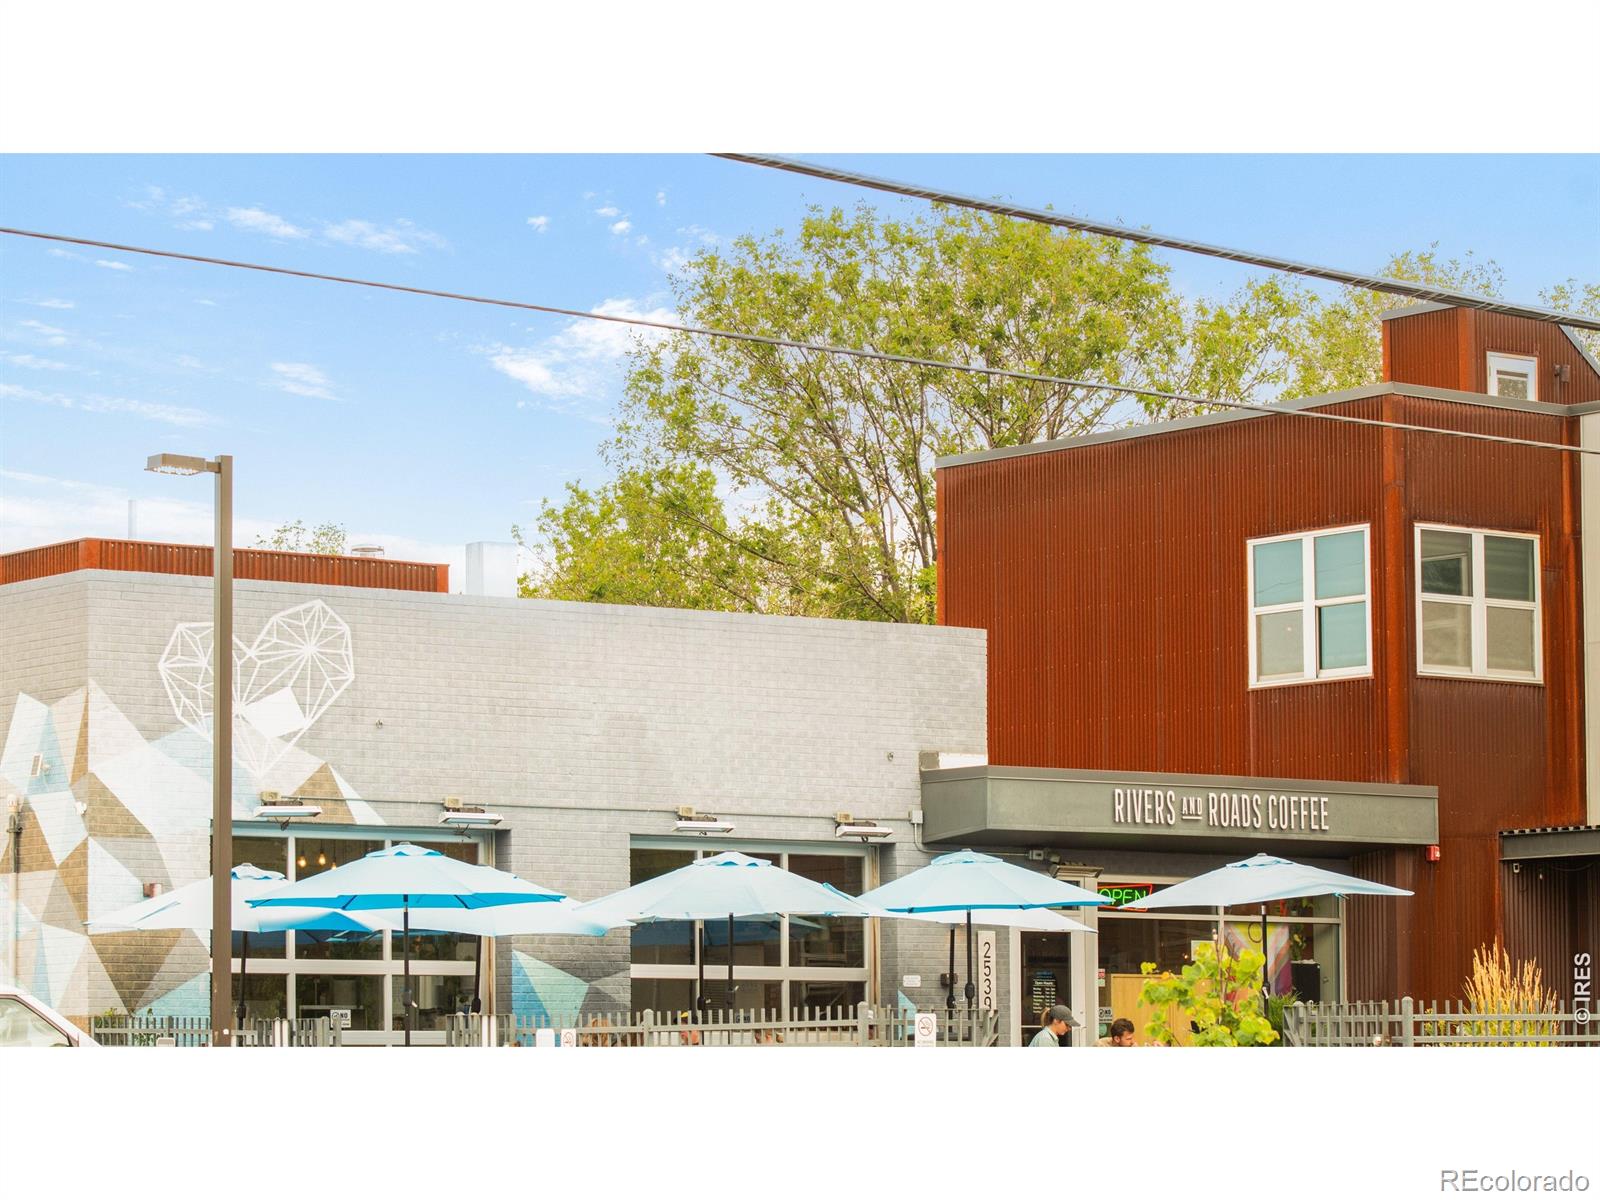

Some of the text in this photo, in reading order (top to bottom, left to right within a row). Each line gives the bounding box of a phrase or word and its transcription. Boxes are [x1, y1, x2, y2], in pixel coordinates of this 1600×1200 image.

[1114, 788, 1330, 831] RIVERS AND ROADS COFFEE
